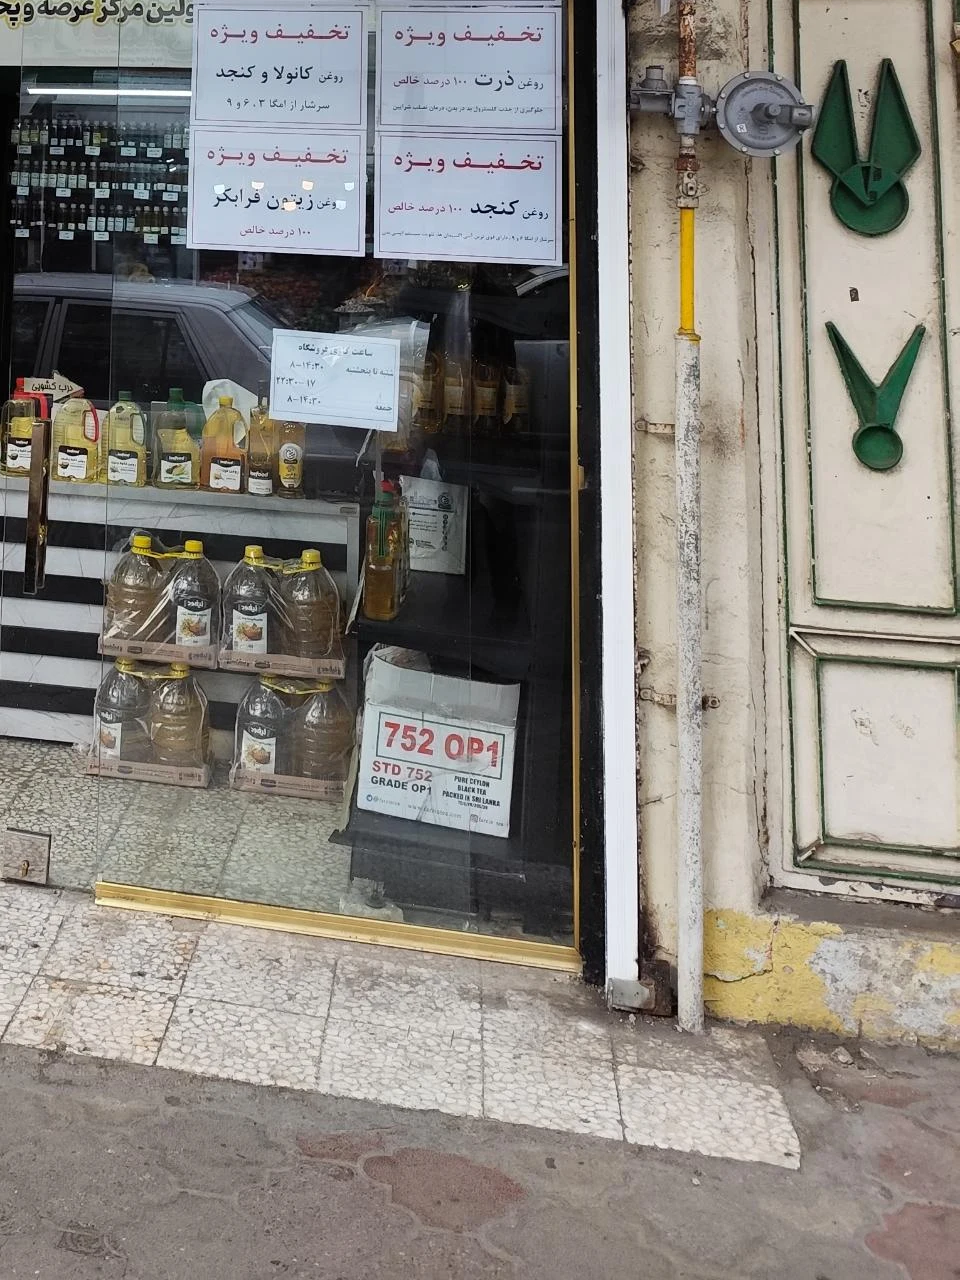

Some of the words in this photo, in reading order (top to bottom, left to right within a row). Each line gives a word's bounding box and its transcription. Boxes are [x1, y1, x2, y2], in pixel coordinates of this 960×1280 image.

[22, 2, 35, 22] و
[210, 24, 259, 44] ویژه
[265, 23, 351, 44] تخفیف
[394, 25, 446, 47] ویژه
[215, 64, 256, 82] کنجد
[260, 71, 269, 84] و
[273, 65, 314, 85] کانولا
[318, 71, 344, 84] روغن
[393, 75, 421, 88] خالص
[474, 70, 515, 92] ذرت
[517, 78, 544, 90] روغن
[269, 98, 287, 109] امگا
[290, 99, 297, 112] از
[300, 100, 330, 112] سرشار
[207, 146, 256, 167] ویژه
[262, 145, 349, 168] تخفیف
[394, 151, 445, 173] ویژه
[452, 151, 544, 174] تخفیف
[316, 197, 337, 210] وغن
[387, 201, 415, 214] خالص
[469, 199, 520, 219] کنجد
[522, 207, 549, 220] روغن
[239, 225, 266, 237] خالص
[384, 721, 435, 756] 752
[444, 733, 499, 768] OP1
[372, 760, 401, 776] STD
[406, 766, 433, 782] 752
[370, 775, 409, 790] GRADE
[411, 783, 432, 796] OP1
